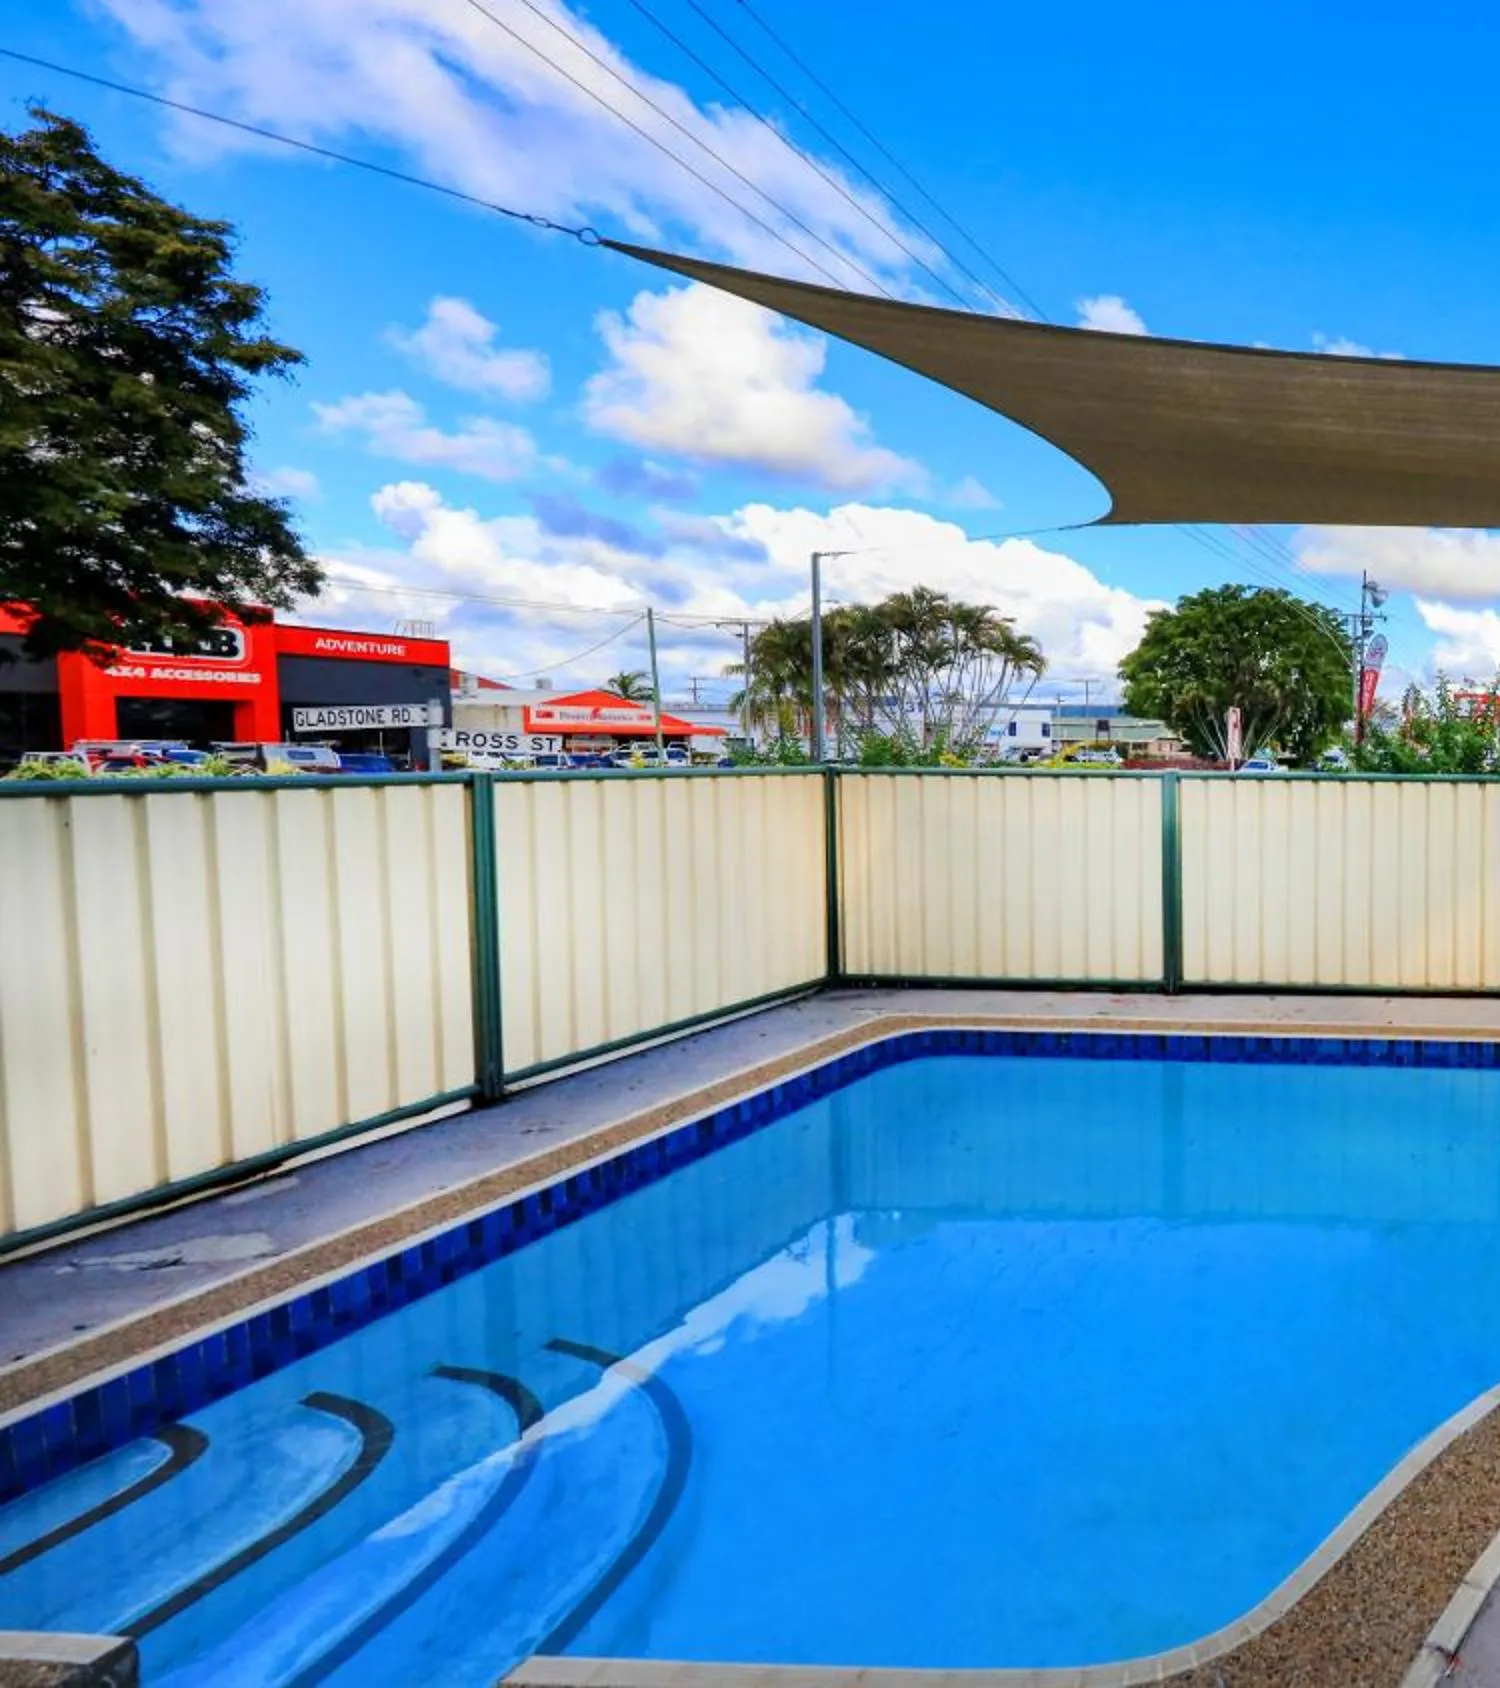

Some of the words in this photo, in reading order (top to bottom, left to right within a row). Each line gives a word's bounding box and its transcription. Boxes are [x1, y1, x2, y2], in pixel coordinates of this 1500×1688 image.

[315, 638, 406, 656] ADVENTURE
[105, 665, 146, 678] 4X4
[150, 668, 261, 684] ACCESSORIES
[295, 706, 386, 727] GLADSTONE
[455, 731, 518, 750] ROSS
